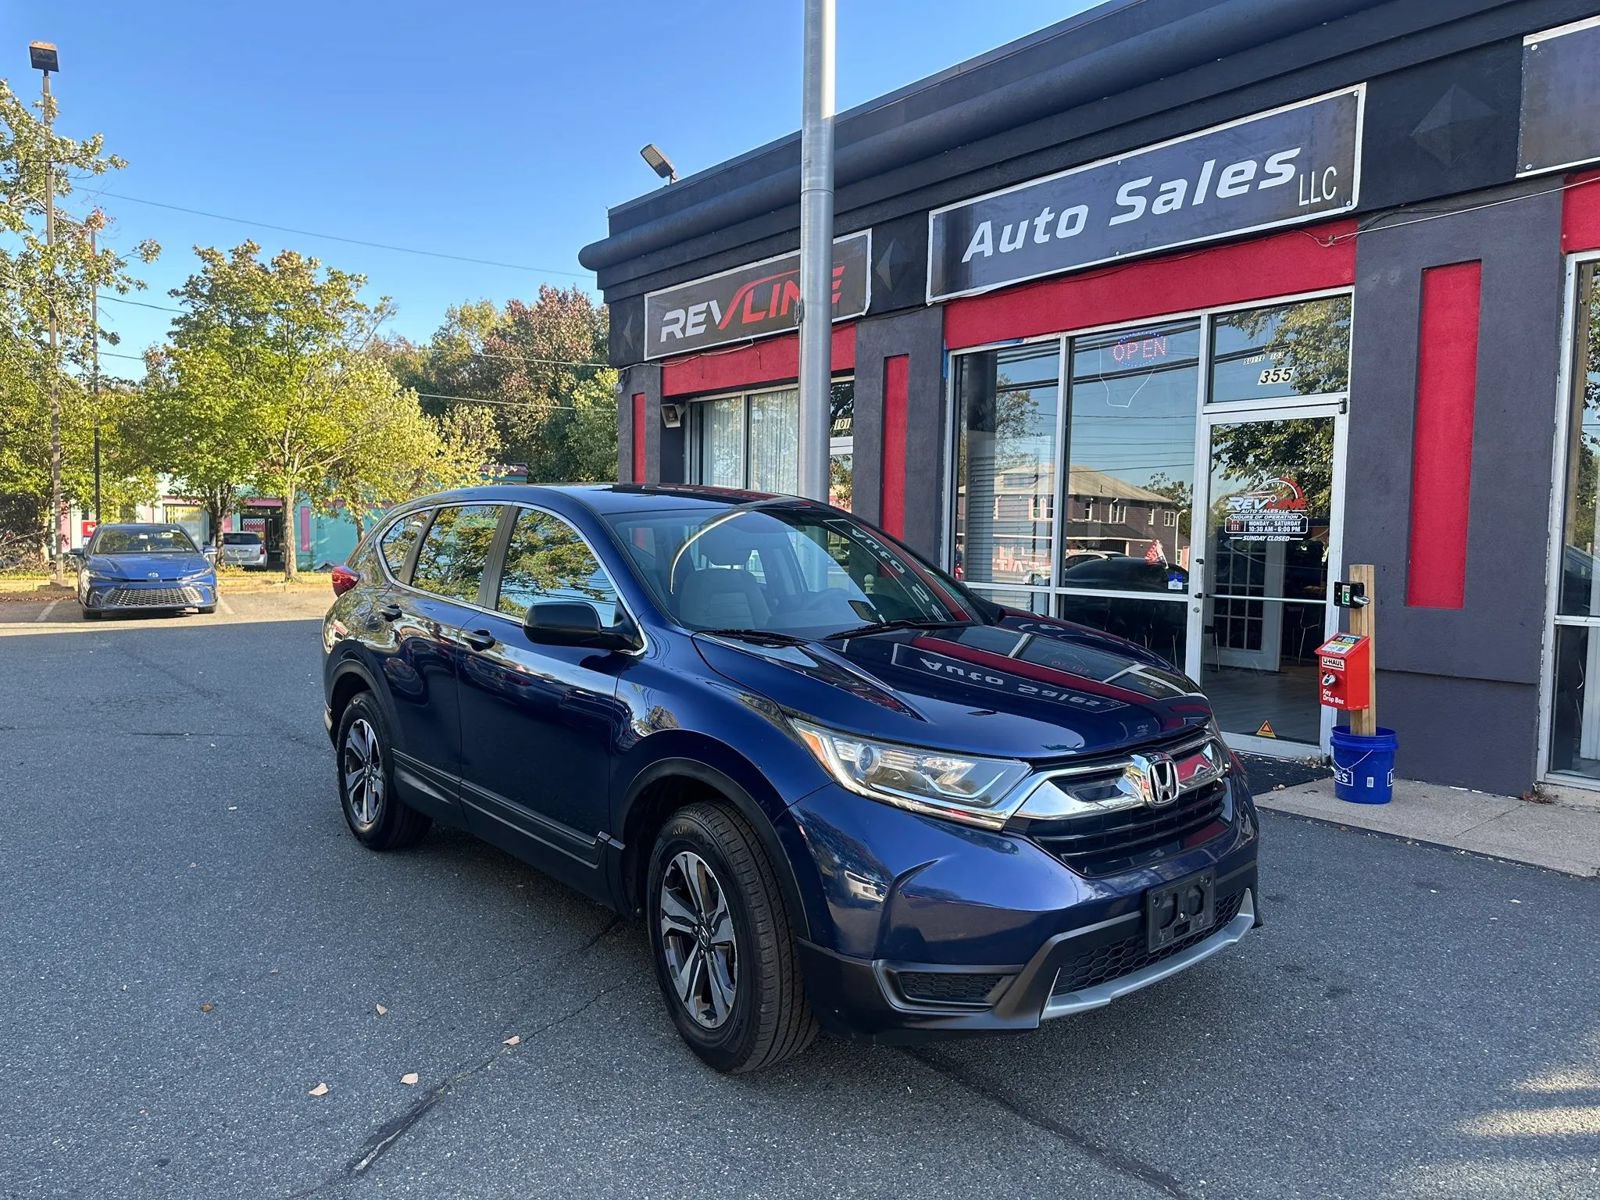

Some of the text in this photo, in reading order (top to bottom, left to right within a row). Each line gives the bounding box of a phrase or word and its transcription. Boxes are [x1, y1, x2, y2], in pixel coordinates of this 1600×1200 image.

[961, 147, 1338, 264] Auto Sales LLC
[1113, 336, 1167, 362] OPEN
[1260, 367, 1293, 384] 355
[1322, 688, 1332, 698] Key
[1322, 694, 1345, 705] Drop Box
